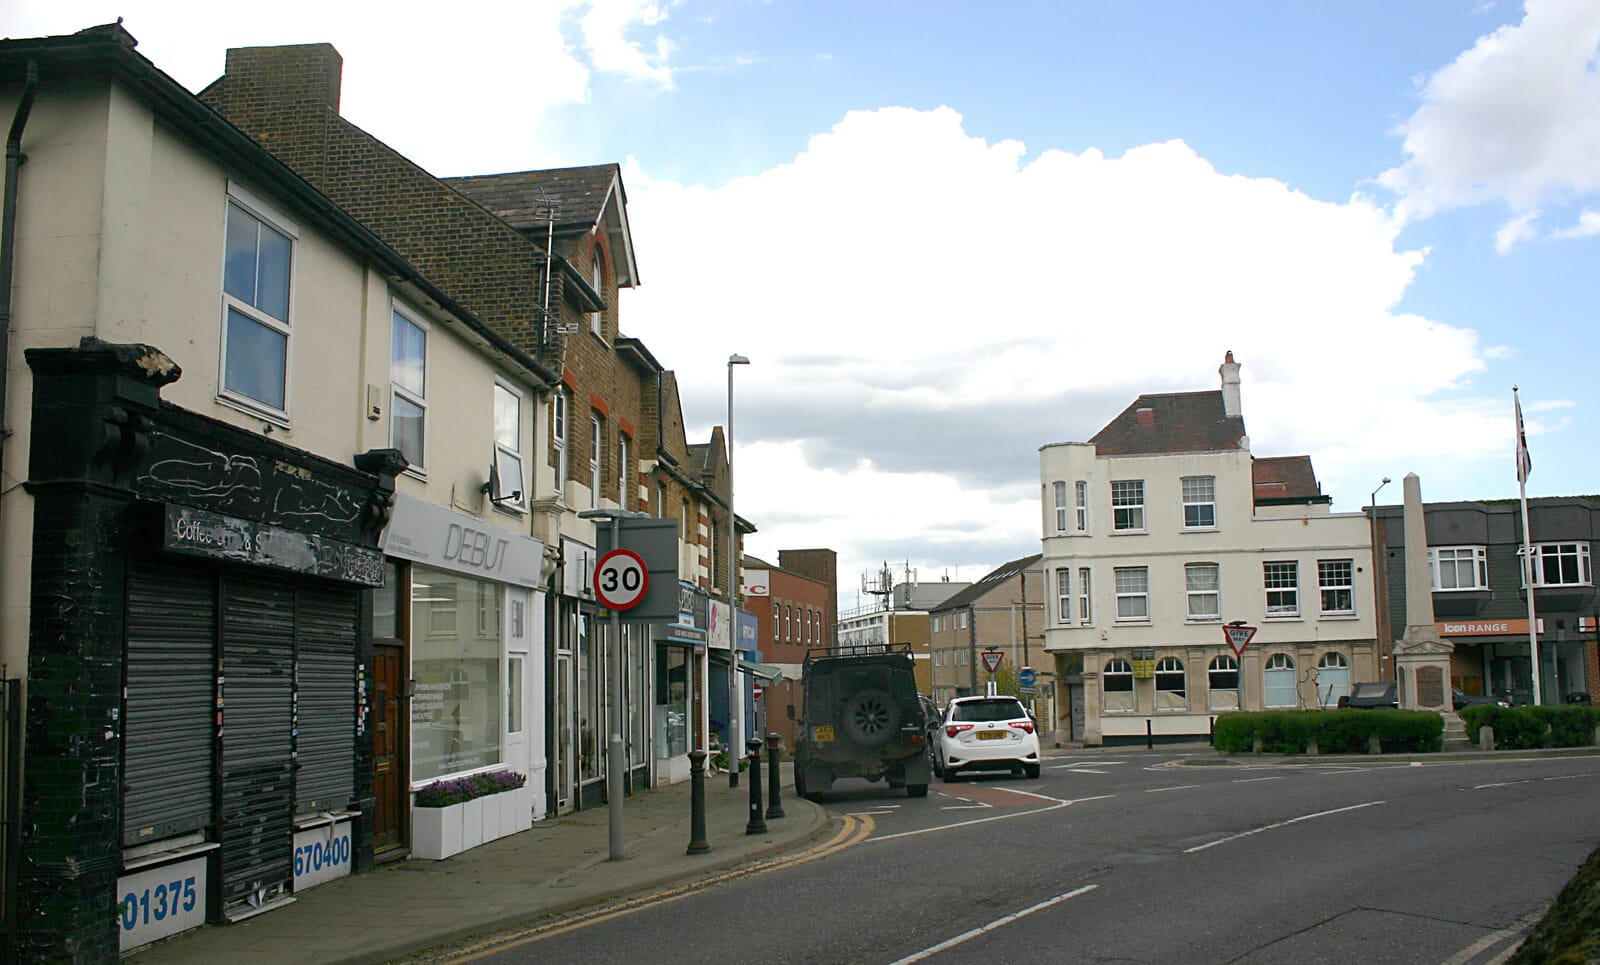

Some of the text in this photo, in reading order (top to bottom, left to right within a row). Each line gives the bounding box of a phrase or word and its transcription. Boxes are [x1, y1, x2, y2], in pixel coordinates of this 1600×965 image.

[176, 517, 213, 545] Coffee
[443, 522, 512, 571] DEBUT
[601, 566, 641, 593] 30
[1230, 629, 1249, 637] GIVE
[1468, 623, 1508, 632] RANGE
[293, 834, 350, 878] 670400
[121, 875, 197, 931] 01375
